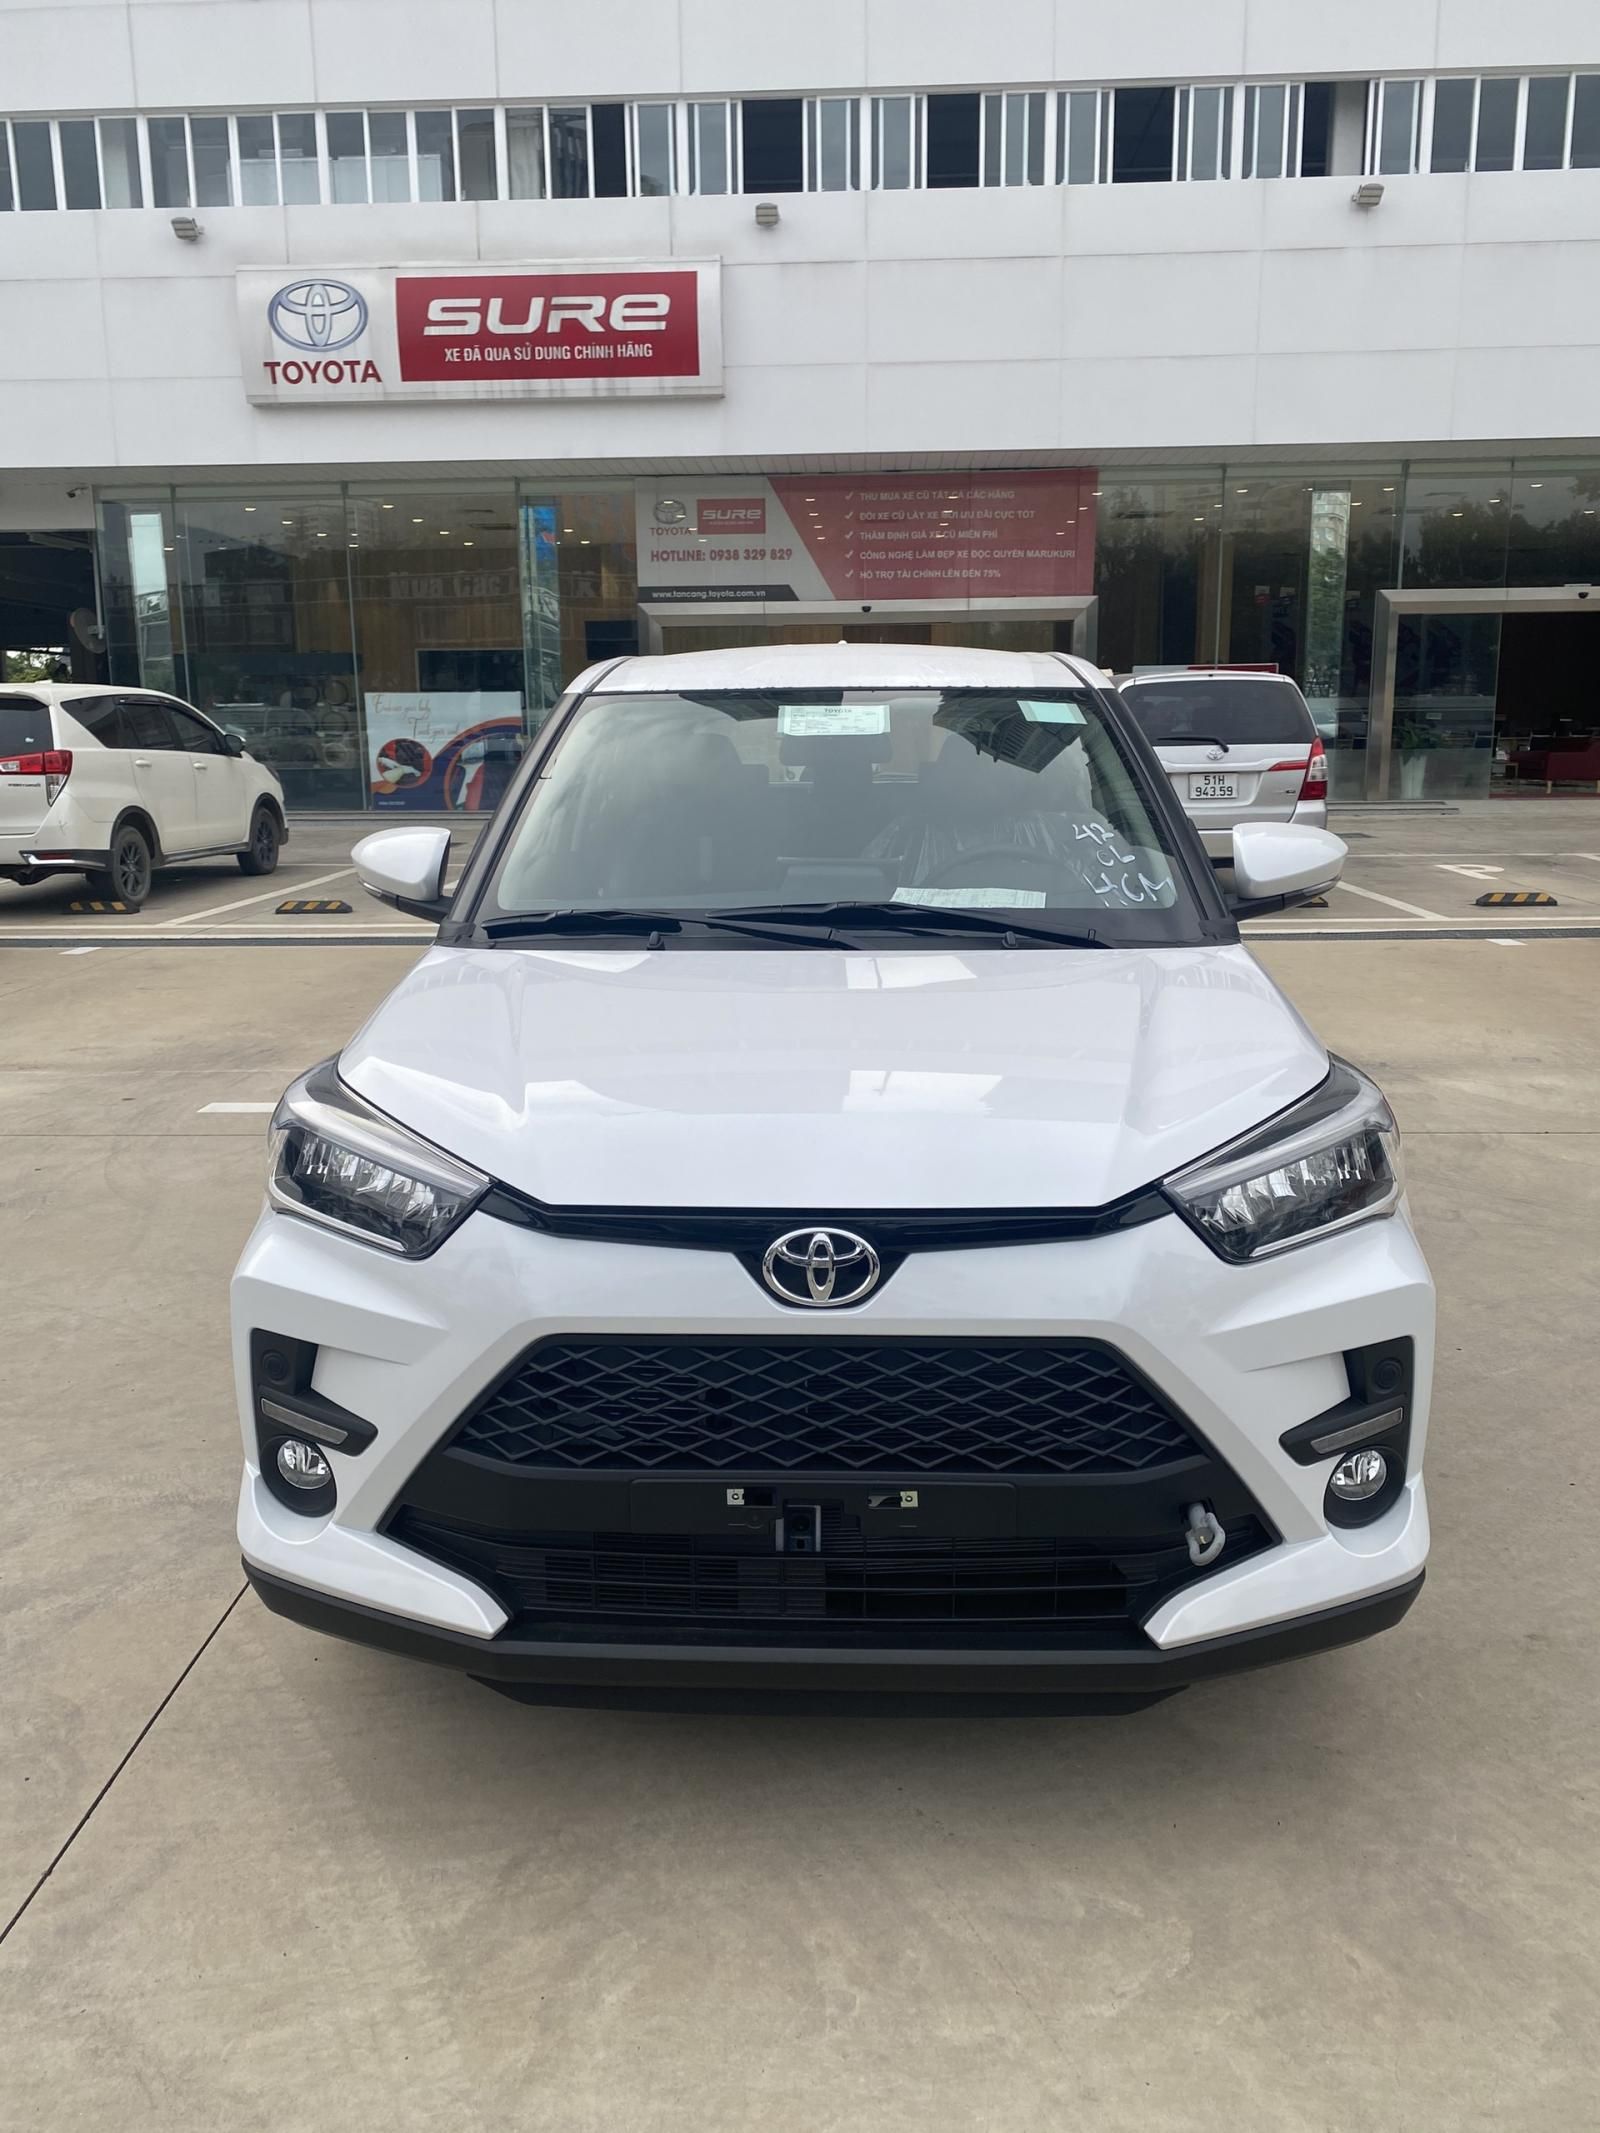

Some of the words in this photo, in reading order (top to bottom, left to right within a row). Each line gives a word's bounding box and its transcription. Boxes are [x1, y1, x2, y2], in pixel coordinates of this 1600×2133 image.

[444, 348, 461, 362] XE
[463, 345, 482, 361] ĐÃ
[484, 347, 511, 361] QUA
[514, 342, 532, 360] SỬ
[617, 341, 653, 358] HÃNG
[263, 360, 383, 384] TOYOTA
[859, 491, 878, 501] THU
[880, 491, 900, 501] MUA
[902, 491, 915, 500] XE
[916, 489, 930, 500] CŨ
[878, 511, 890, 521] XE
[891, 509, 905, 520] CŨ
[927, 511, 939, 520] XE
[649, 527, 694, 537] TOYOTA
[651, 549, 706, 562] HOTLINE:
[709, 549, 740, 561] 0938
[743, 548, 766, 561] 329
[859, 549, 886, 560] CÔNG
[888, 550, 914, 560] NGHỆ
[957, 549, 969, 559] XE
[1026, 549, 1076, 558] MARUKURI
[1203, 774, 1226, 786] 51H
[1195, 786, 1234, 798] 943.59
